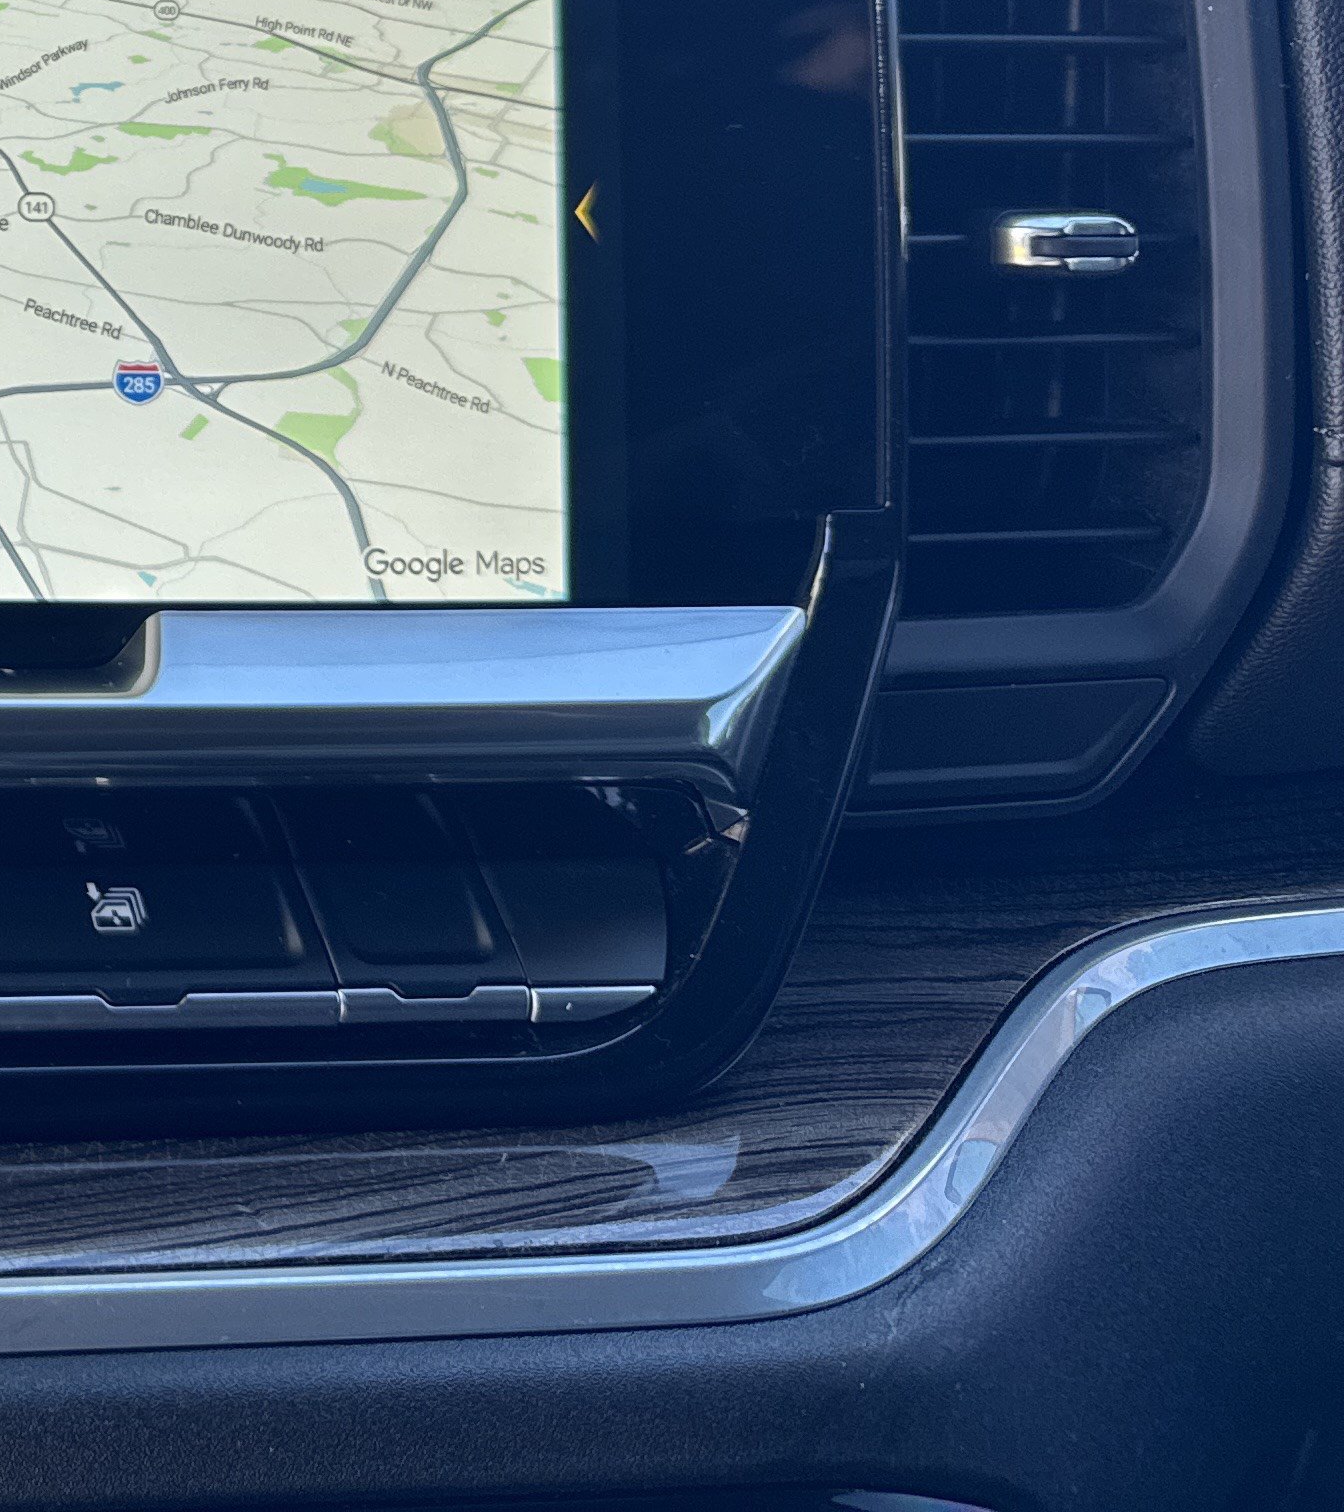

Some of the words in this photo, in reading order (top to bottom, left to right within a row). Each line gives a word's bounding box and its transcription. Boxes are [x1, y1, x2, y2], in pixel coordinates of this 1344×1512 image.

[158, 6, 176, 16] 400
[412, 0, 433, 11] NW
[255, 16, 282, 33] High
[284, 21, 315, 37] Point
[318, 28, 334, 42] Rd
[336, 33, 353, 48] NE
[41, 37, 89, 67] Parkway
[164, 82, 216, 104] Johnson
[218, 77, 250, 92] Ferry
[253, 77, 270, 91] Rd
[24, 201, 48, 214] 141
[144, 208, 220, 235] Chamblee
[222, 223, 301, 253] Dunwoody
[303, 237, 324, 253] Rd
[23, 298, 99, 333] Peachtree
[100, 320, 122, 340] Rd
[122, 377, 155, 394] 285
[381, 360, 397, 377] N
[395, 367, 468, 407] Peachtree
[469, 395, 490, 414] Rd
[364, 547, 464, 583] Google
[475, 551, 546, 579] Maps
